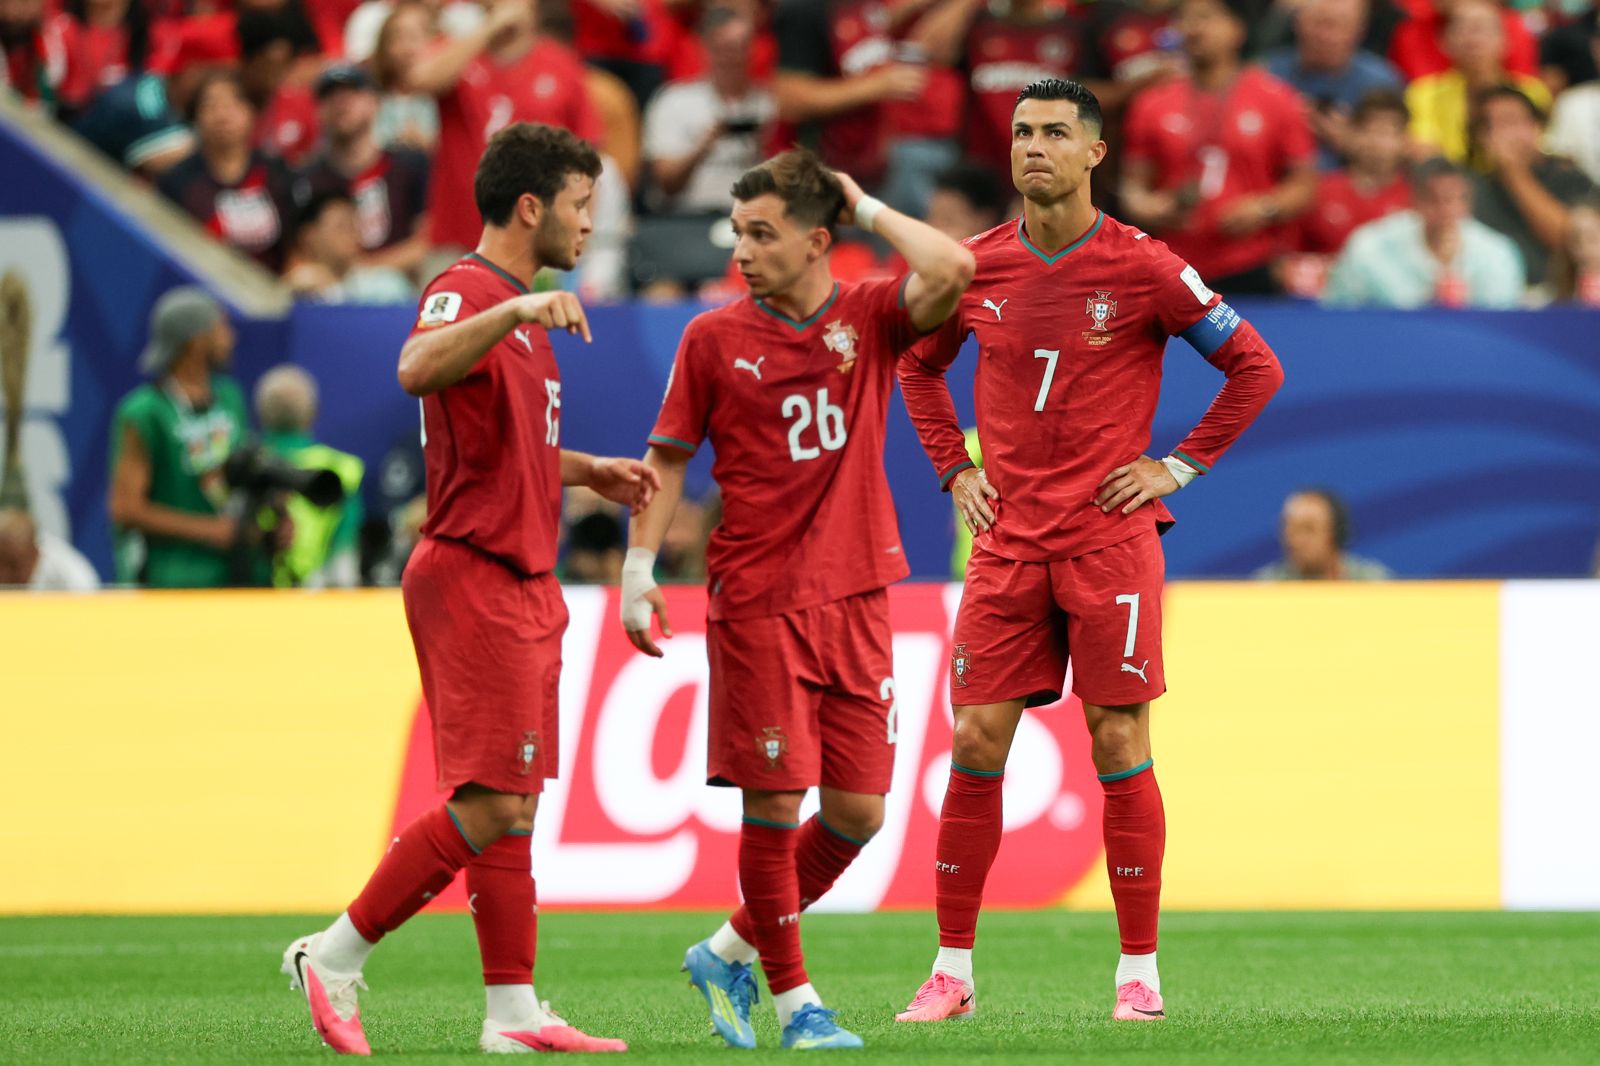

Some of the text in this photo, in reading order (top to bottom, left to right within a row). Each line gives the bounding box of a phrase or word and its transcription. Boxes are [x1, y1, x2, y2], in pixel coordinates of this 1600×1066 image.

[1034, 349, 1060, 412] 7
[782, 387, 847, 462] 26
[1115, 592, 1140, 658] 7
